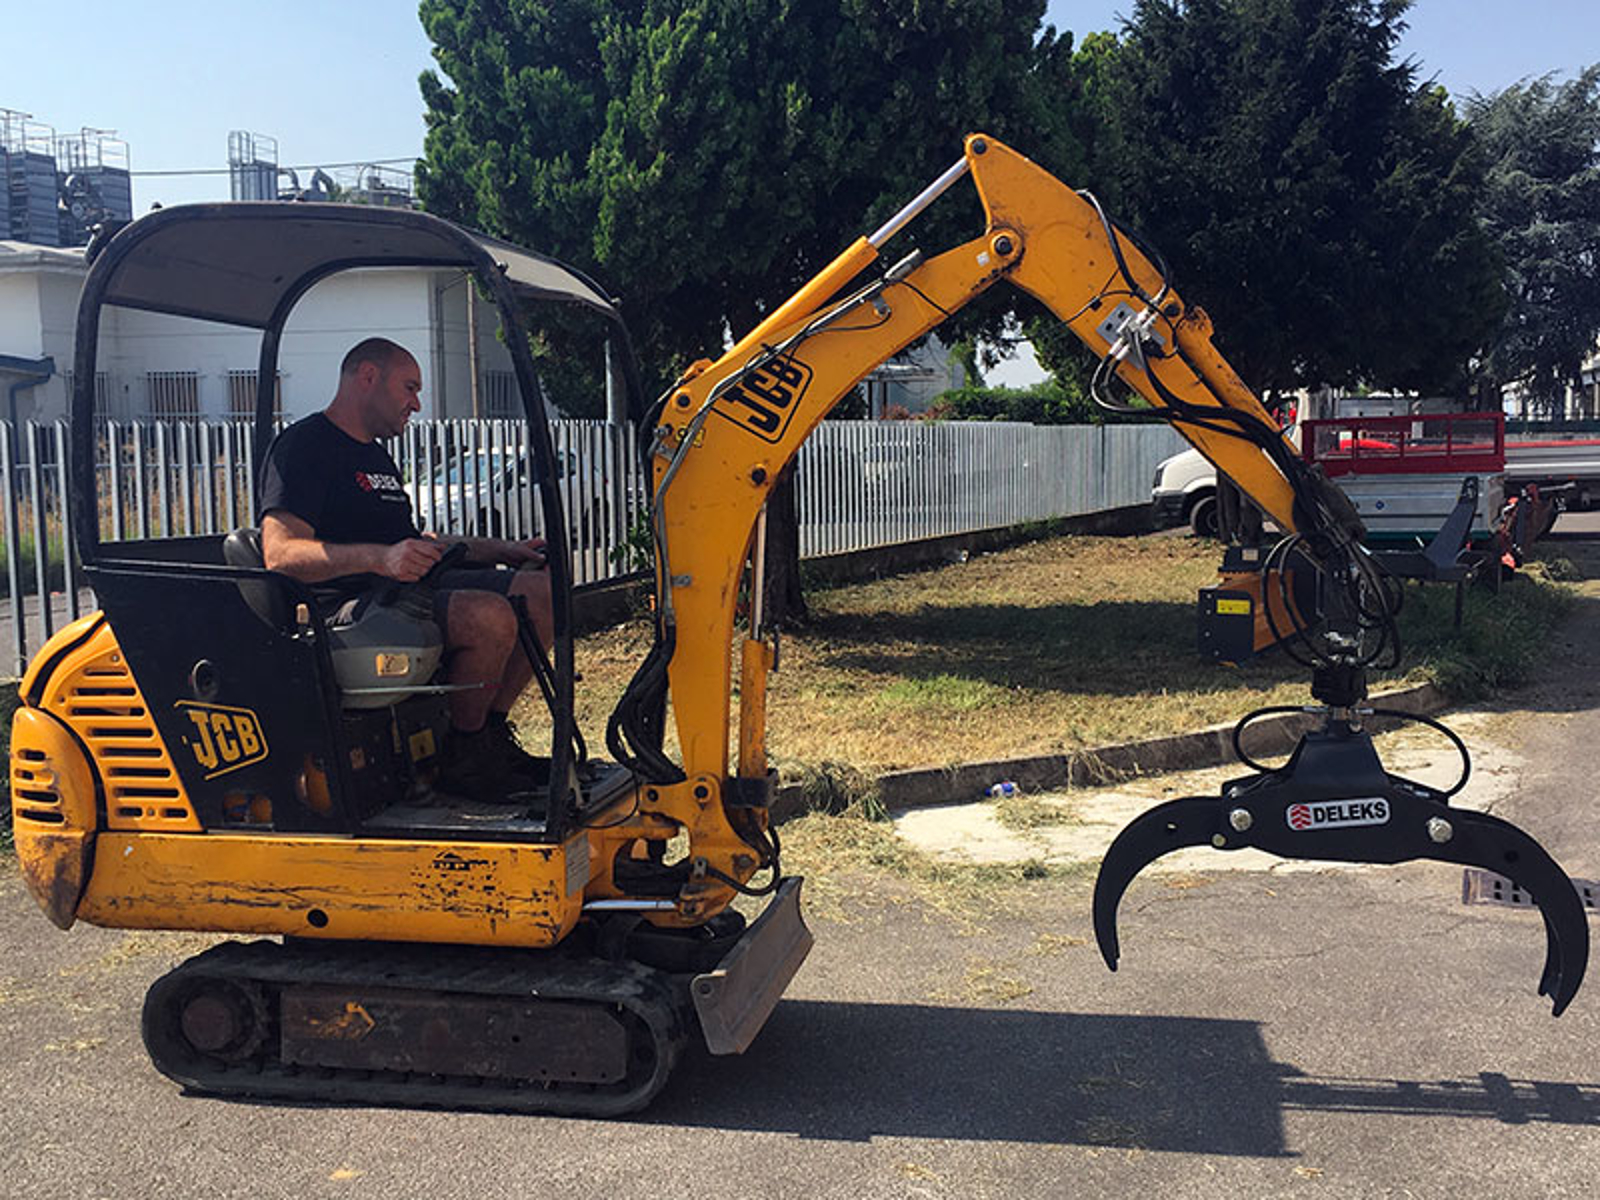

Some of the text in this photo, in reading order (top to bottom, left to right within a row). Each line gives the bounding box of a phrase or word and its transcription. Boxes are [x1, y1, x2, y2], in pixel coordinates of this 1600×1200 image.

[721, 355, 804, 434] JCB
[187, 709, 260, 769] JCB
[1313, 801, 1387, 823] DELEKS
